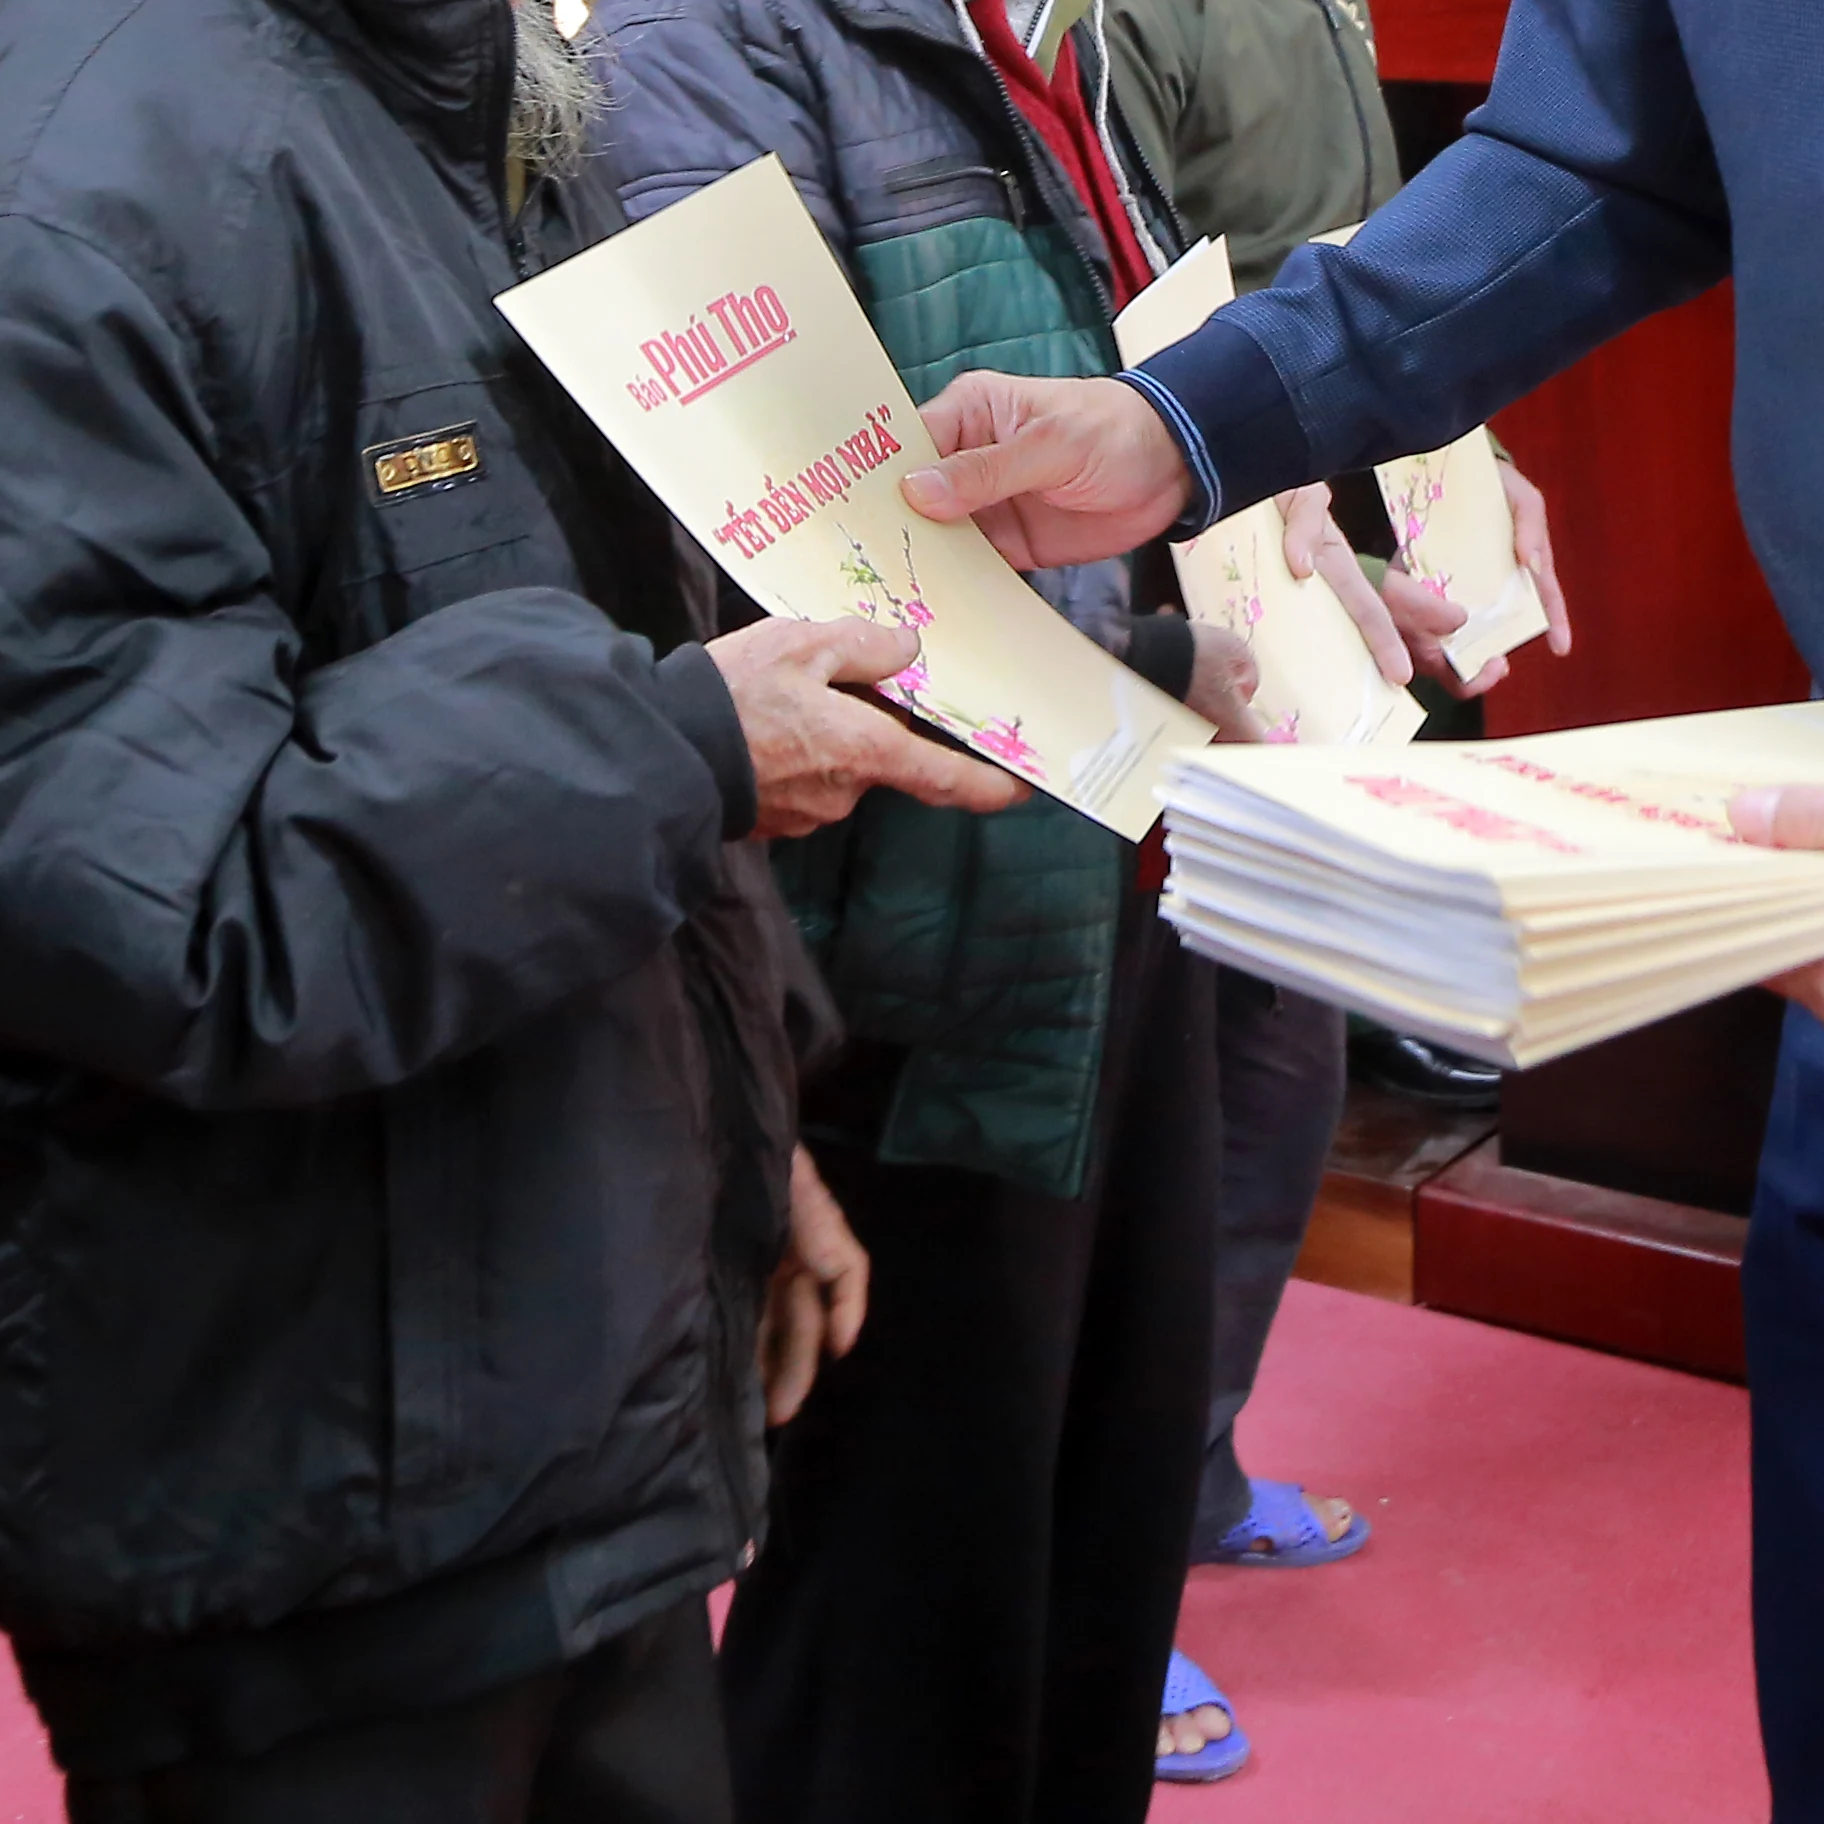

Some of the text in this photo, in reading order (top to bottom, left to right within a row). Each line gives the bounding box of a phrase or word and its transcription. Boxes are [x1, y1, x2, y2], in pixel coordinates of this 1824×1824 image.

[626, 374, 668, 412] Báo
[639, 313, 728, 397] Phú
[757, 473, 816, 535] ĐẾN
[797, 453, 852, 507] MỌI
